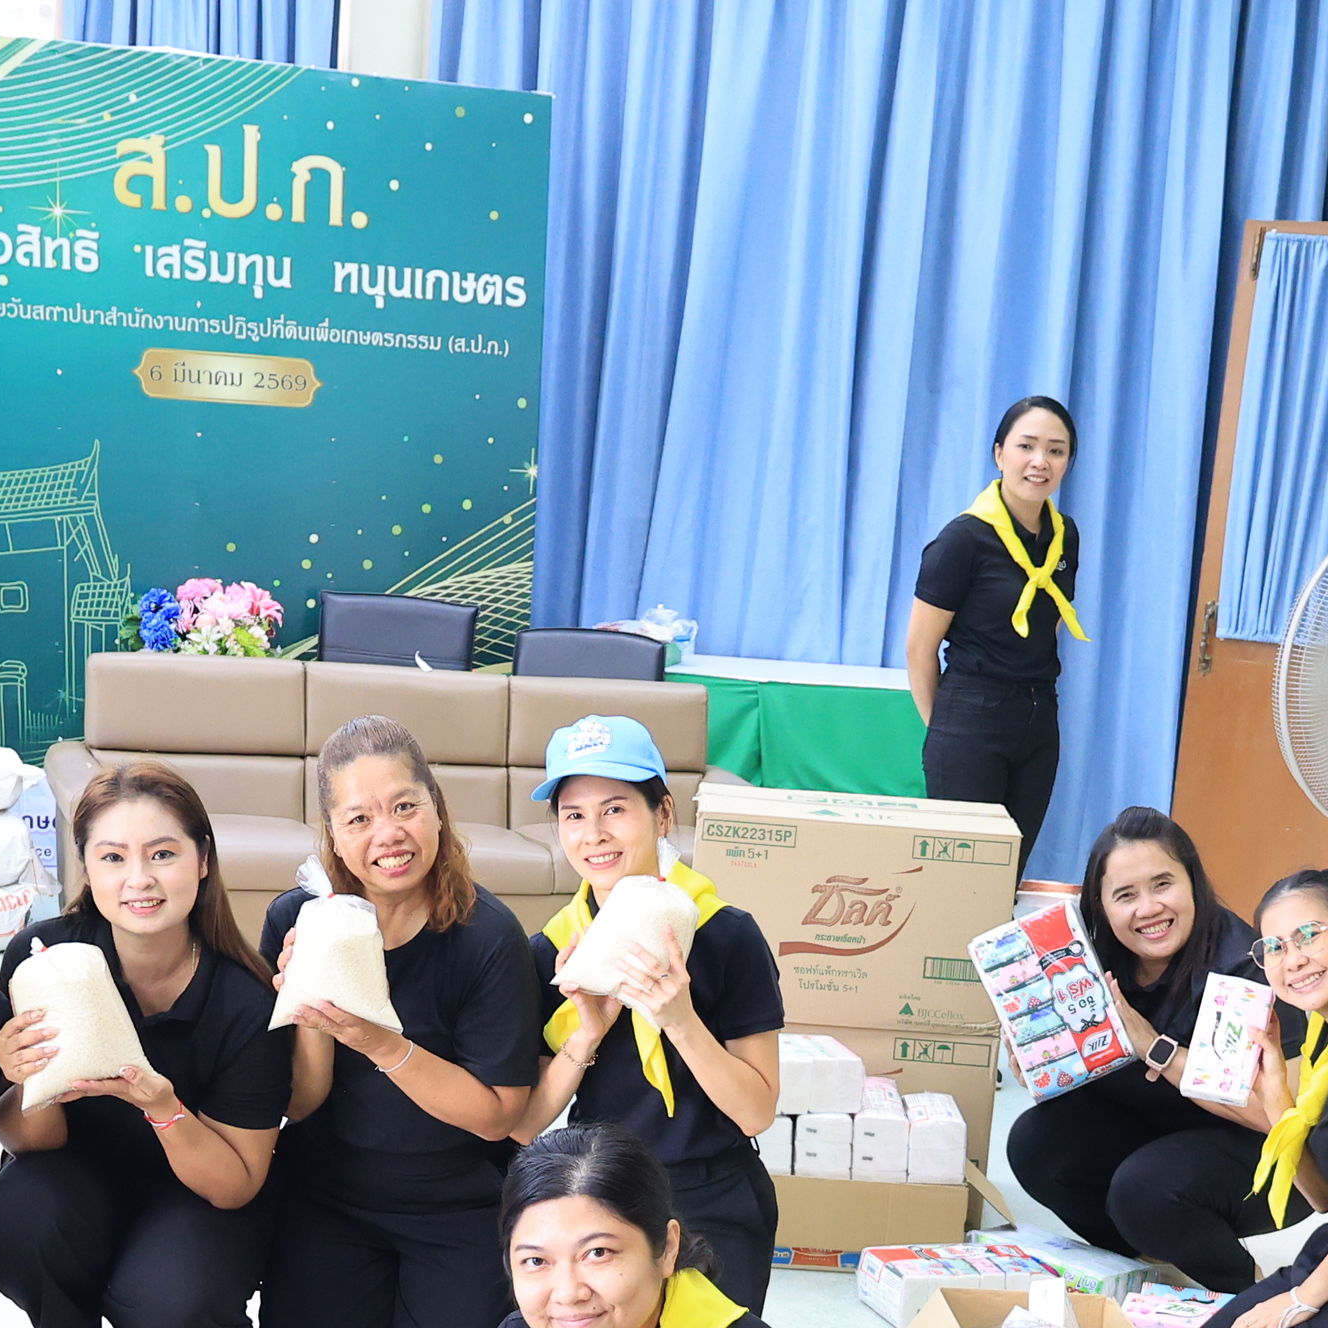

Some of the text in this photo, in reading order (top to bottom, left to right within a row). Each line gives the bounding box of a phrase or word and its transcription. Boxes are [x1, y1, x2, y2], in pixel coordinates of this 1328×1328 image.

[112, 123, 369, 230] ส.ป.ก.
[143, 237, 292, 299] เสริมทุน
[333, 258, 527, 309] หนุนเกษตร
[448, 333, 510, 357] (ส.ป.ก.)
[149, 361, 307, 392] 6 มีนาคม 2569
[706, 823, 793, 843] CSZK22315P
[747, 847, 769, 860] 5+1
[842, 984, 859, 994] 5+1
[1055, 977, 1095, 1002] ฟรี 1
[1067, 994, 1098, 1015] ซื้อ 5
[1087, 1034, 1109, 1052] Zilk
